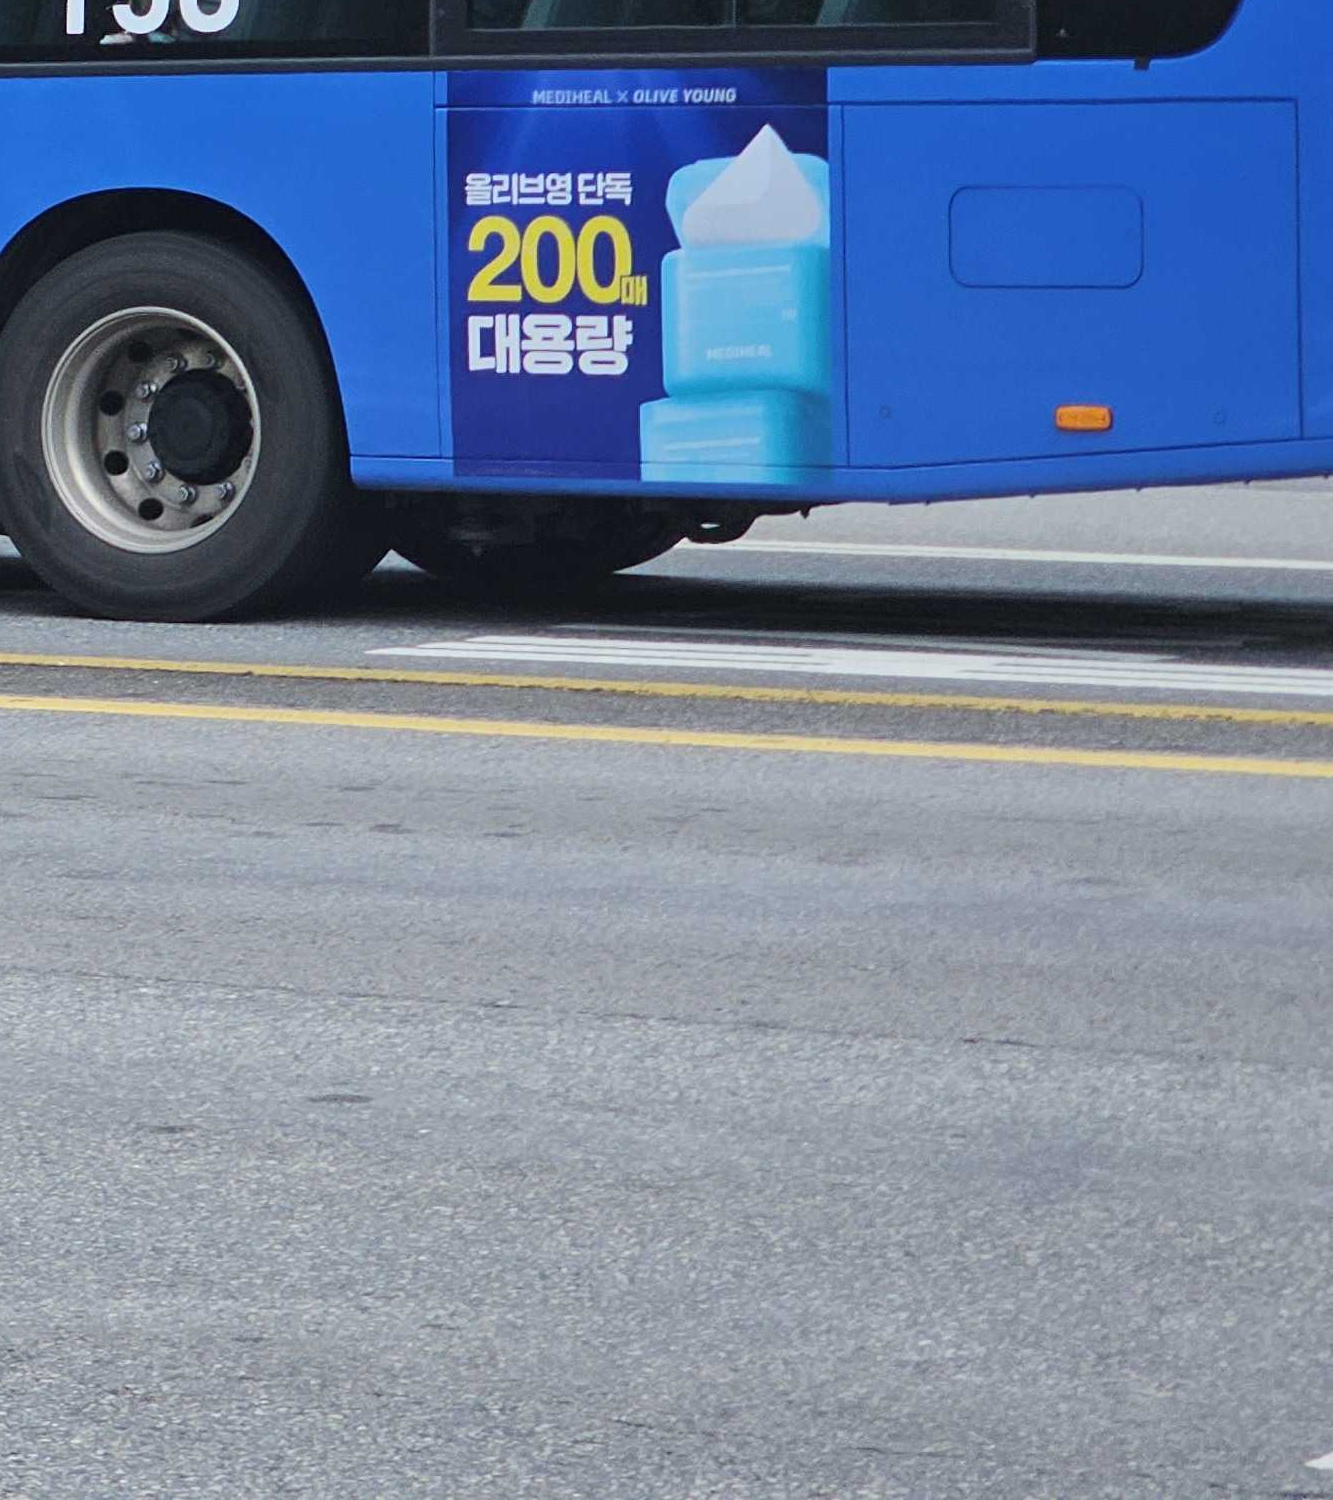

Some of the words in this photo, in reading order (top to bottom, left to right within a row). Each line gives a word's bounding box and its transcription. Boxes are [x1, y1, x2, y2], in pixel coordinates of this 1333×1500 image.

[532, 89, 613, 105] MEDIHEAL
[633, 88, 679, 104] OLIVE
[682, 87, 737, 103] YOUNG
[464, 171, 573, 206] 올리브영
[576, 170, 633, 206] 단독
[467, 214, 648, 306] 200매
[467, 313, 634, 376] 대용량
